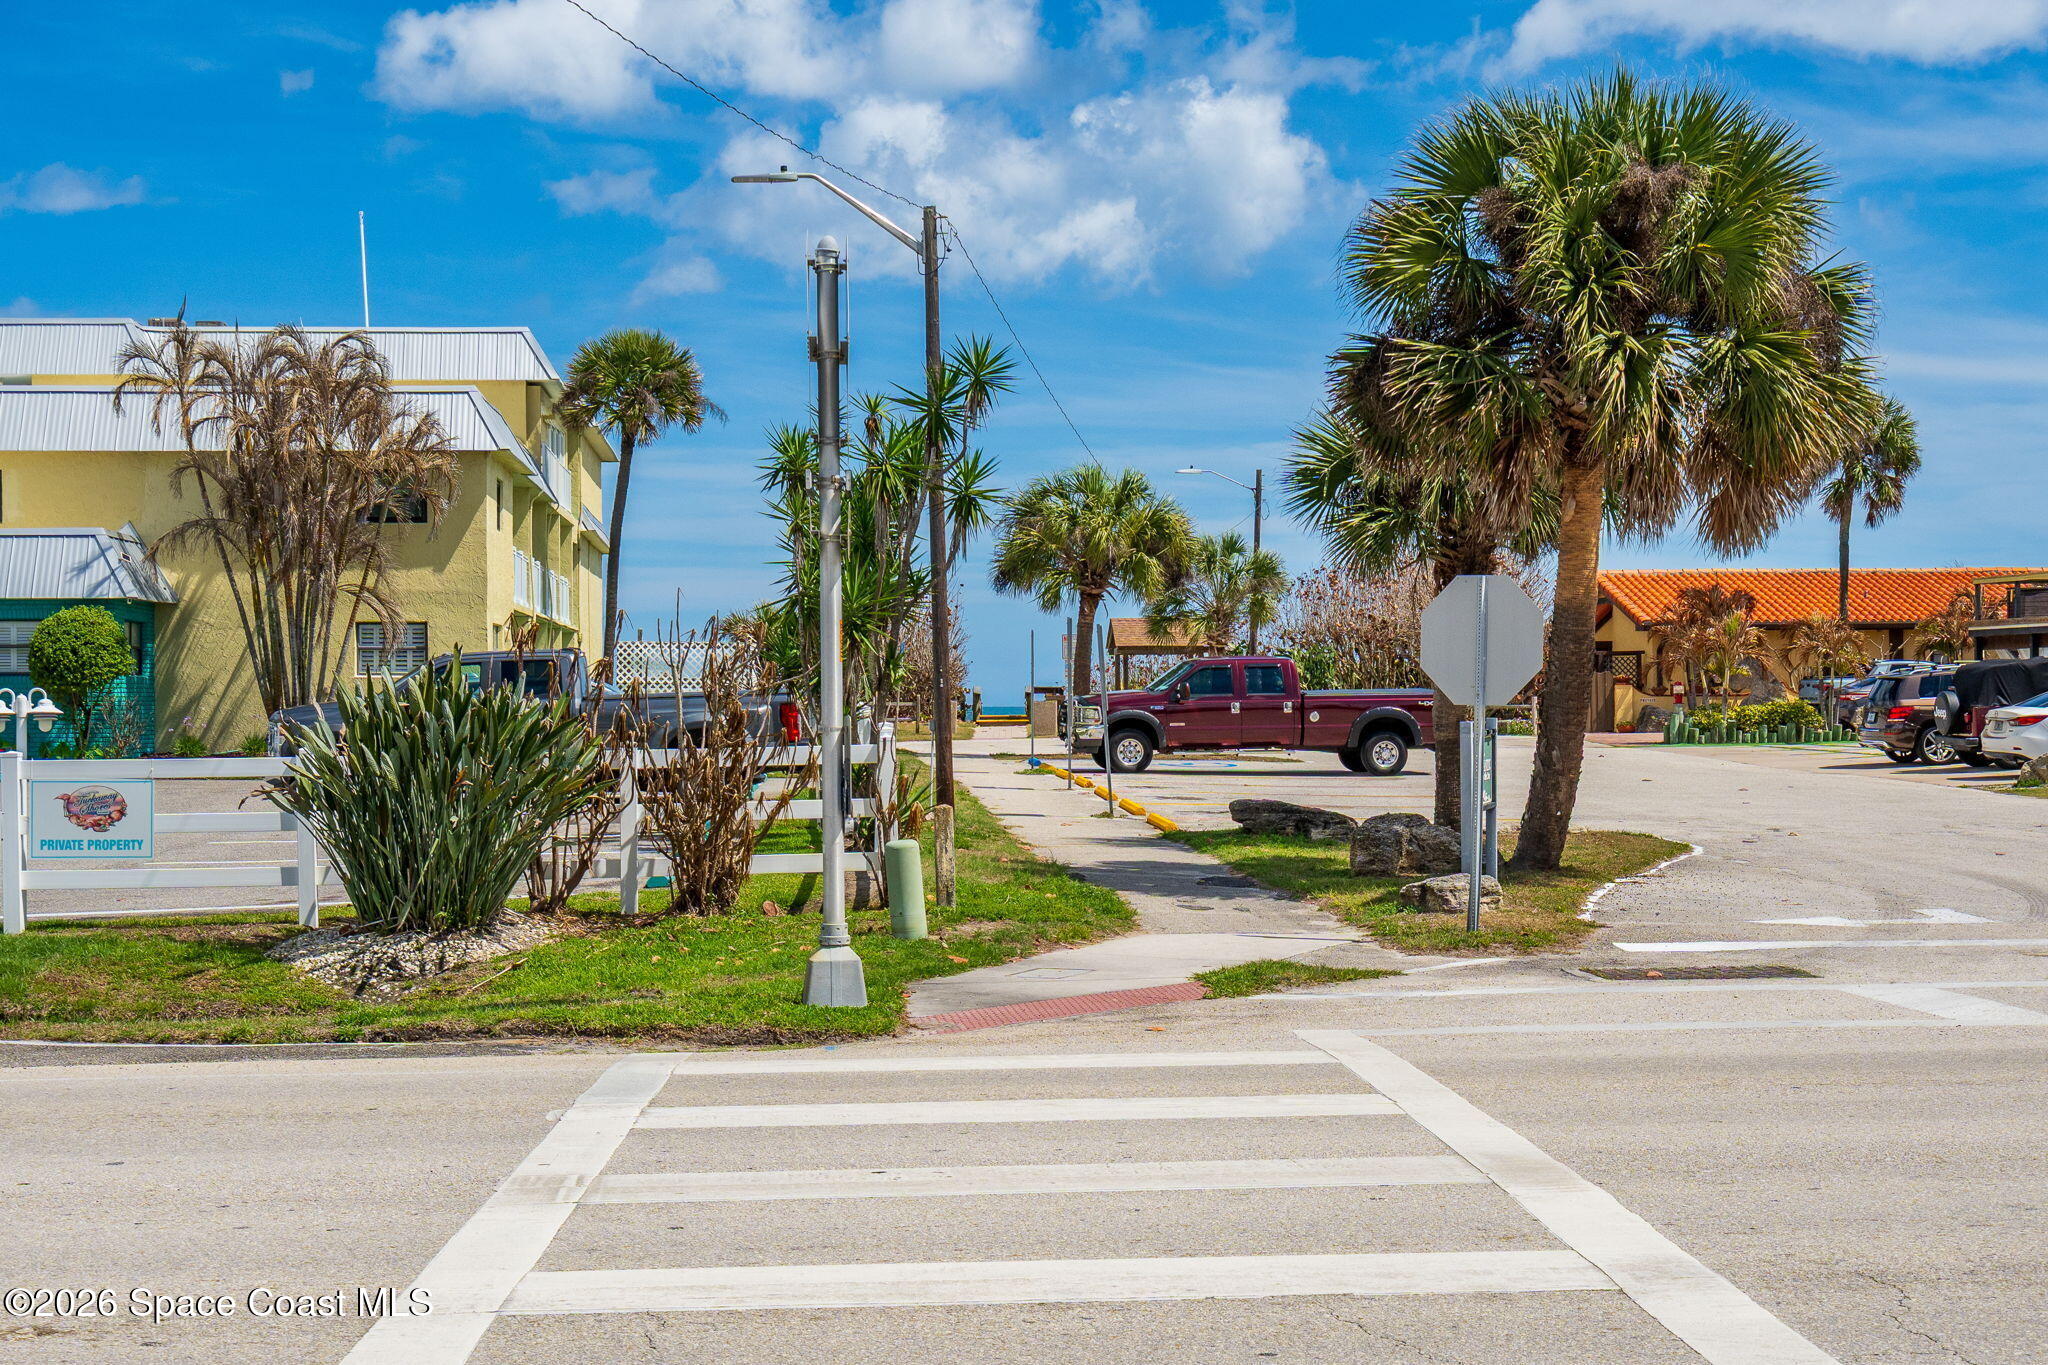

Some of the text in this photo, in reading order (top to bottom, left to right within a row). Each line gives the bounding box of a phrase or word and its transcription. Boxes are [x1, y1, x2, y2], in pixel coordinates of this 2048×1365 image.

[1933, 706, 1947, 720] Jeep
[40, 839, 144, 851] PRIVATE PROPERTY
